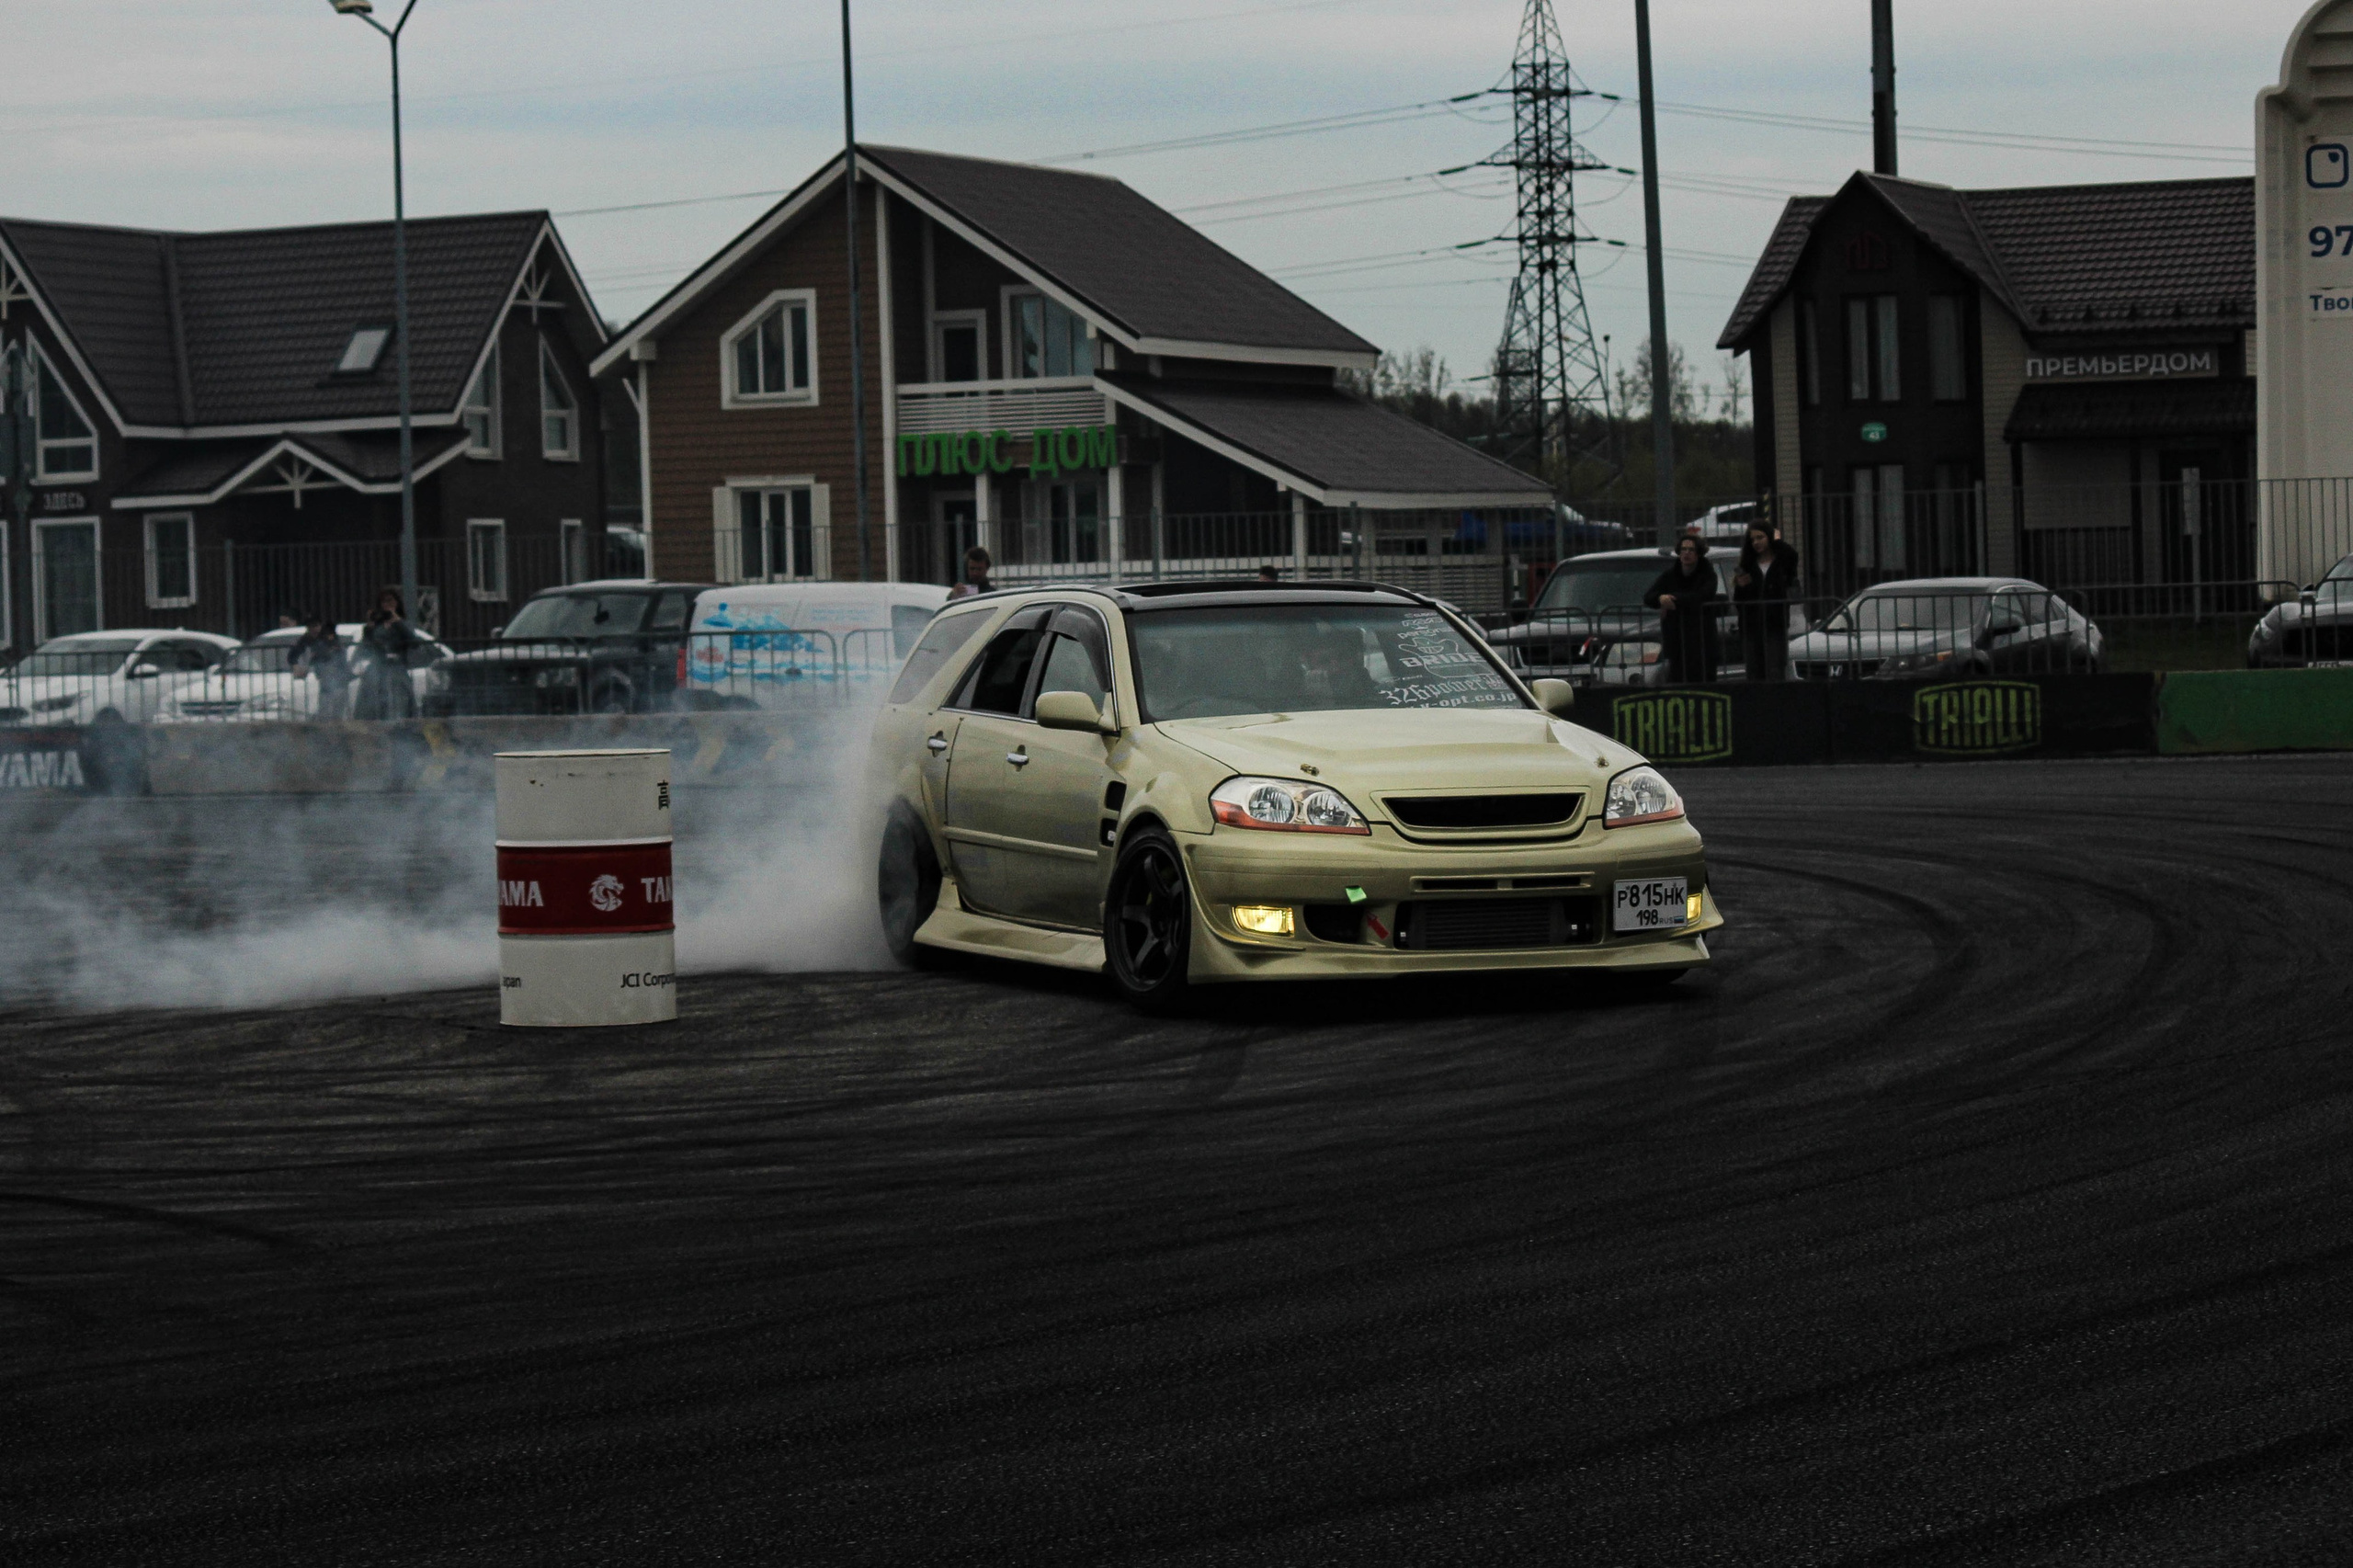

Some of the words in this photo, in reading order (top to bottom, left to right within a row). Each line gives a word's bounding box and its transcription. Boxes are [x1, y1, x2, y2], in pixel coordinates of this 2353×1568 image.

[2310, 295, 2353, 312] Тво
[2026, 352, 2211, 377] ПРЕМЬЕРДОМ
[897, 430, 1011, 477] ПЛЮС
[1029, 424, 1118, 481] ДОМ
[1620, 697, 1723, 755] TRIALLI
[1922, 687, 2032, 746] TRIALLI
[1637, 909, 1658, 926] 198
